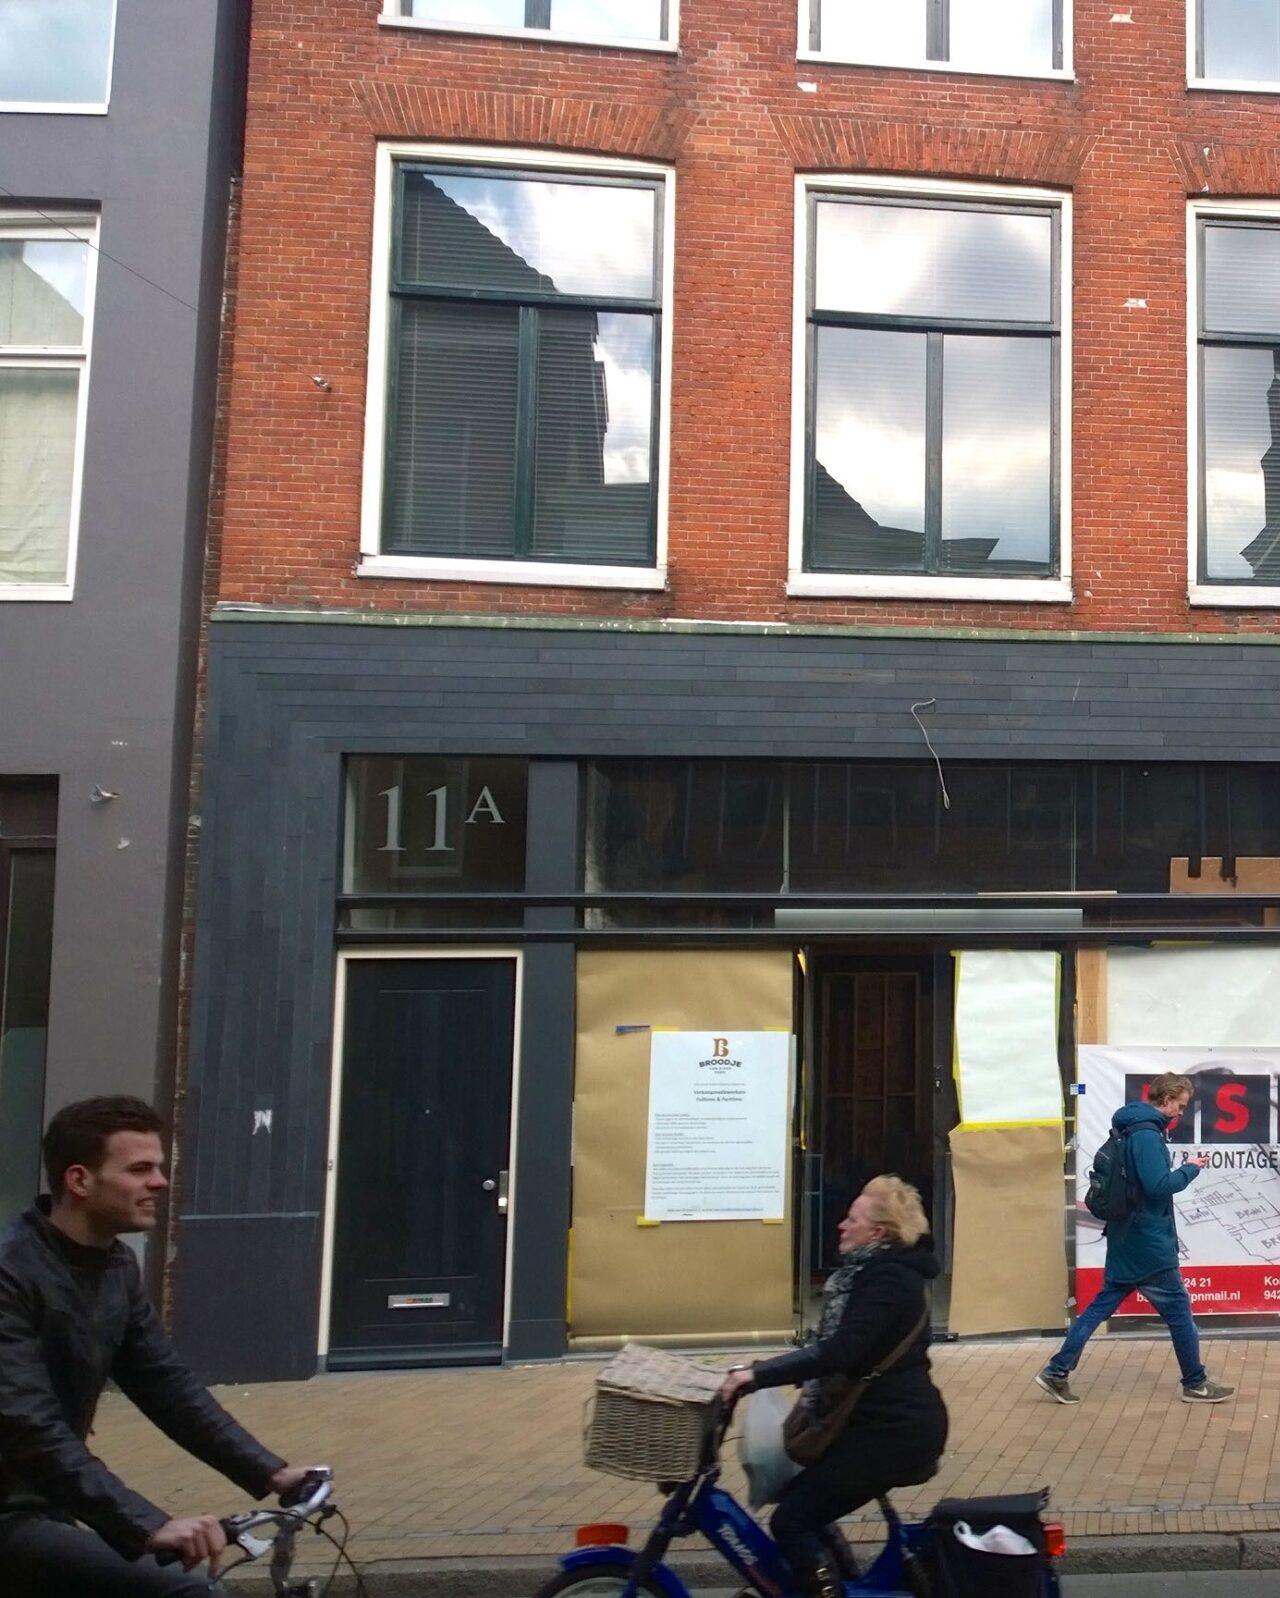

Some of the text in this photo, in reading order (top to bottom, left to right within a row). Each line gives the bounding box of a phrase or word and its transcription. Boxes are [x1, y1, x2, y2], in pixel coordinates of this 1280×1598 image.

[712, 1038, 729, 1057] B
[698, 1058, 742, 1068] BROODJE
[1199, 1277, 1212, 1288] 21
